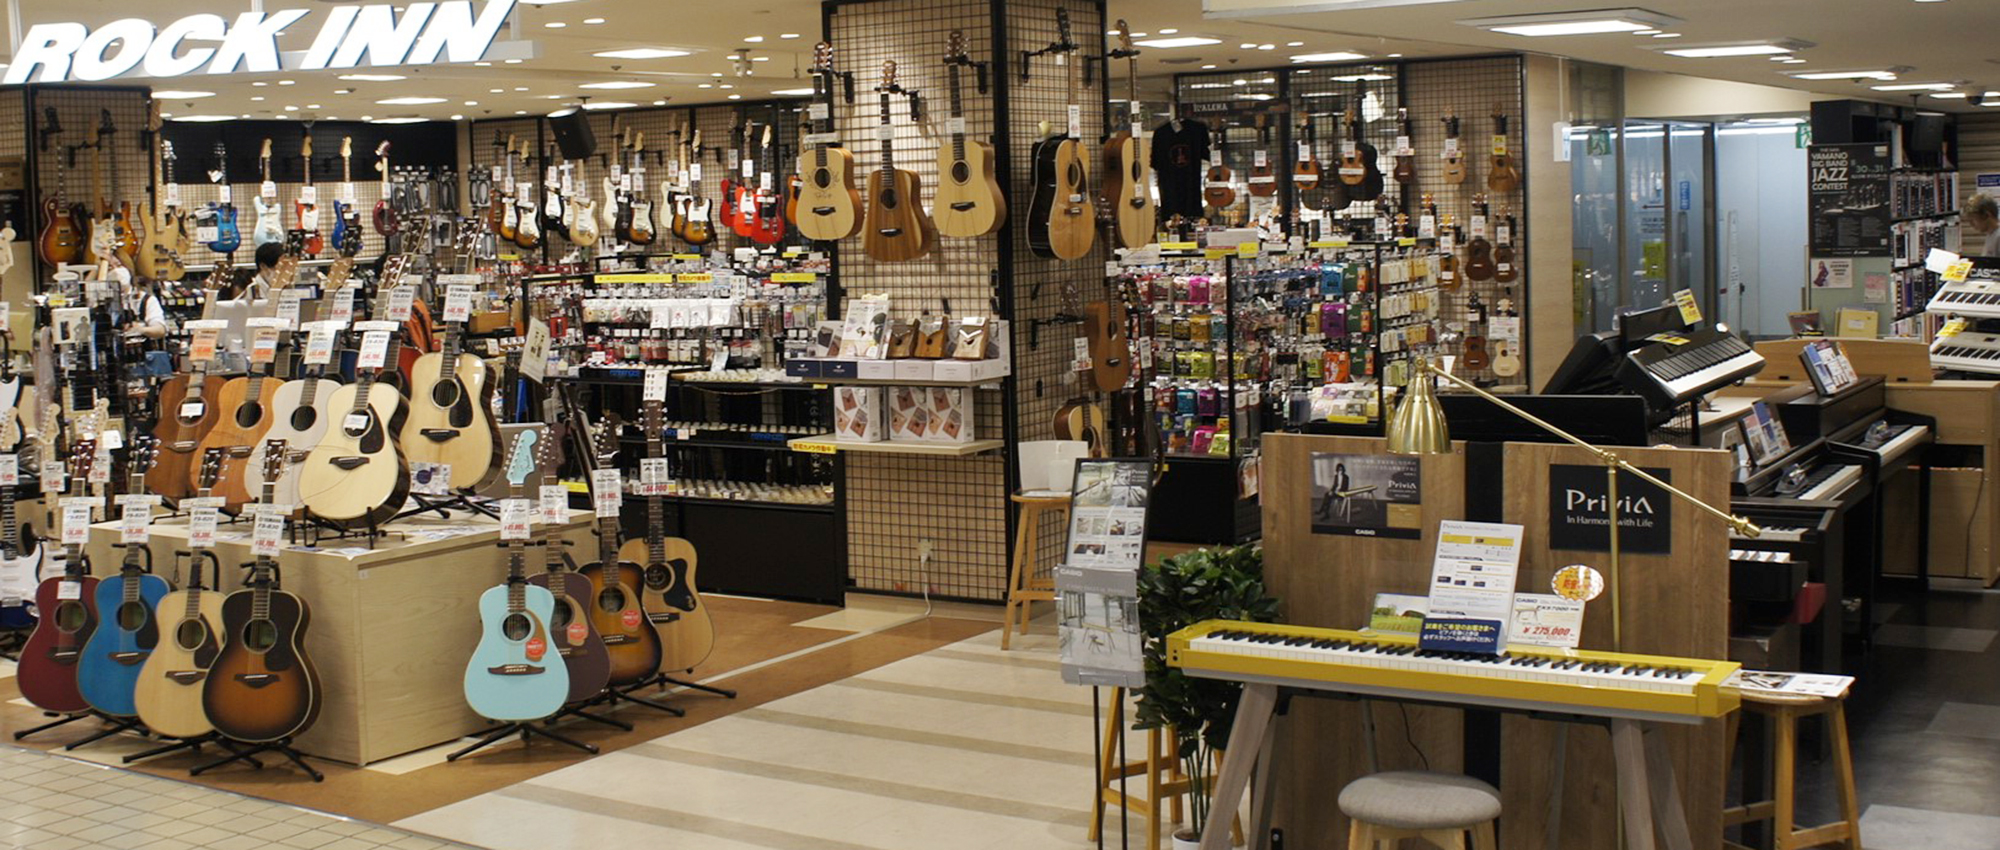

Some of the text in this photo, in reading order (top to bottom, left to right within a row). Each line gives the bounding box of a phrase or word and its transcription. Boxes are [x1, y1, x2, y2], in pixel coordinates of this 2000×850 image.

[2, 0, 517, 84] ROCK INN
[1811, 152, 1848, 160] YAMANO
[1812, 168, 1848, 183] JAZZ
[1811, 183, 1848, 191] CONTEST
[1566, 515, 1576, 524] In
[1577, 515, 1612, 526] Harmon
[1636, 519, 1654, 528] Life
[1533, 627, 1571, 636] 275,000
